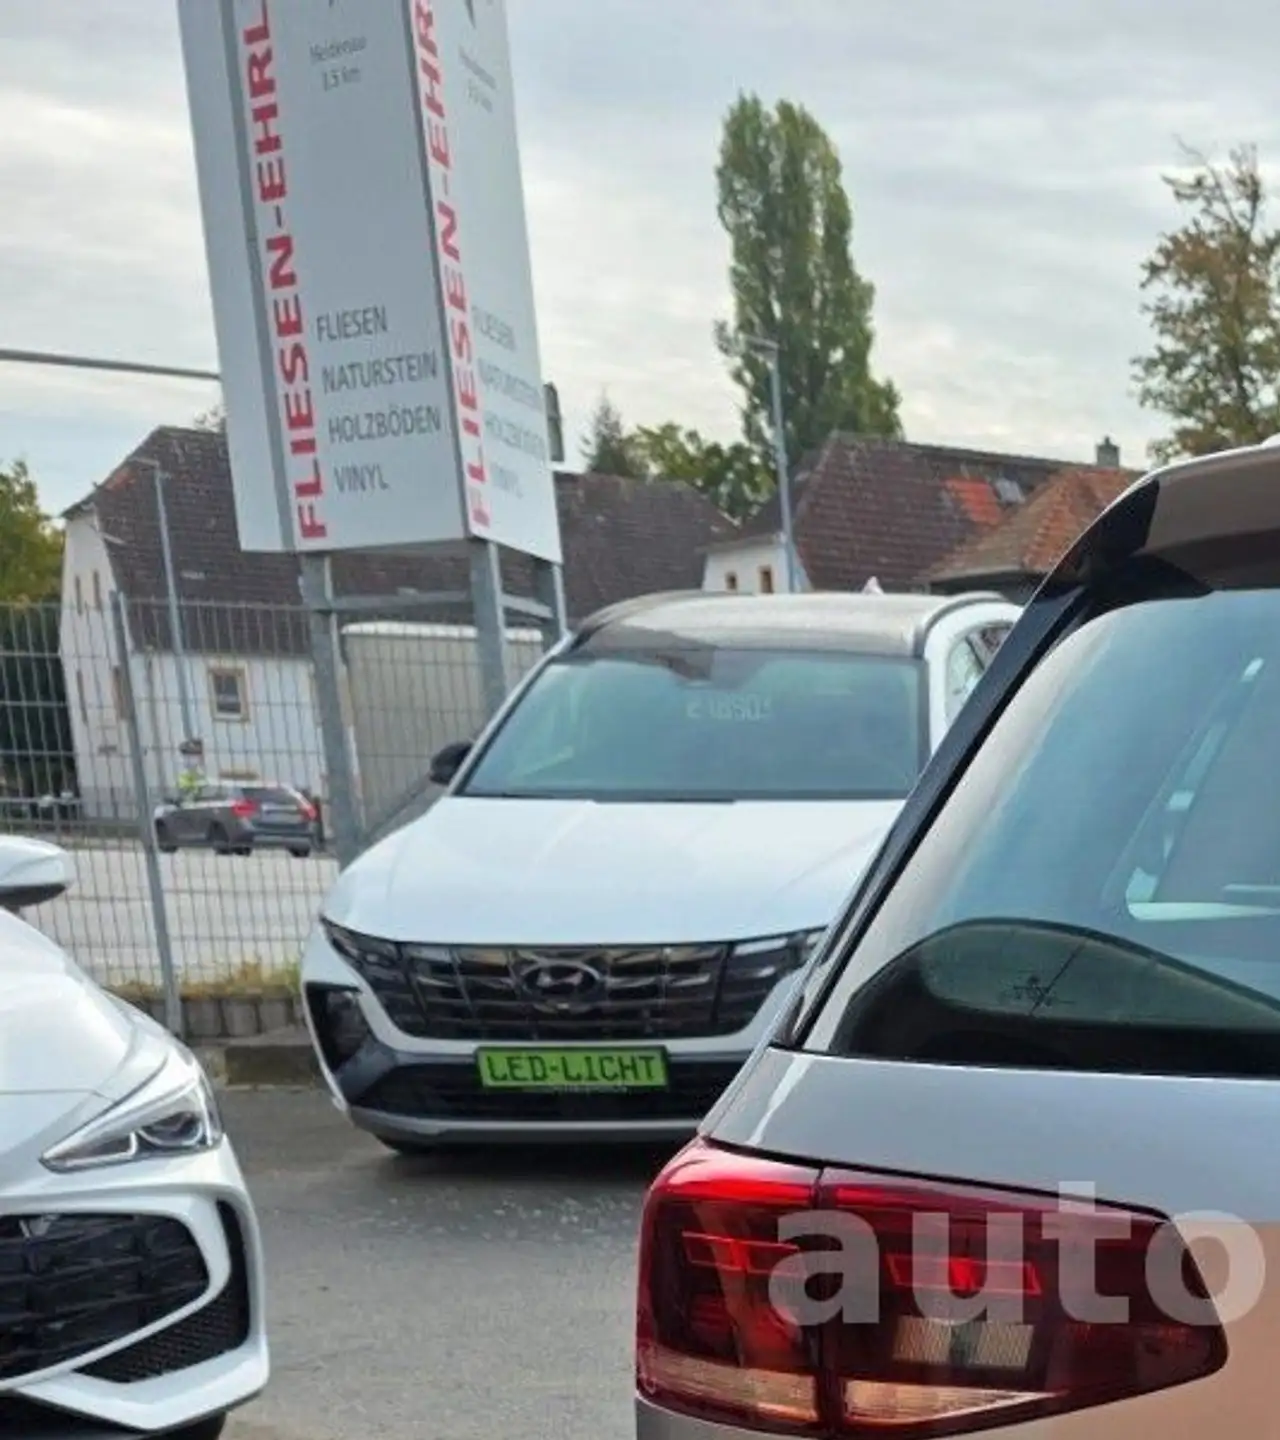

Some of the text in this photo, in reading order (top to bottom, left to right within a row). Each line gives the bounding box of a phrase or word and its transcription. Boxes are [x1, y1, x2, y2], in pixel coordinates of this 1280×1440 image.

[316, 306, 389, 342] FLIESEN
[322, 351, 438, 395] NATURSTEIN
[328, 404, 441, 445] HOLZBÖDEN
[333, 463, 390, 494] VINYL
[486, 1055, 655, 1082] LED-LICHT
